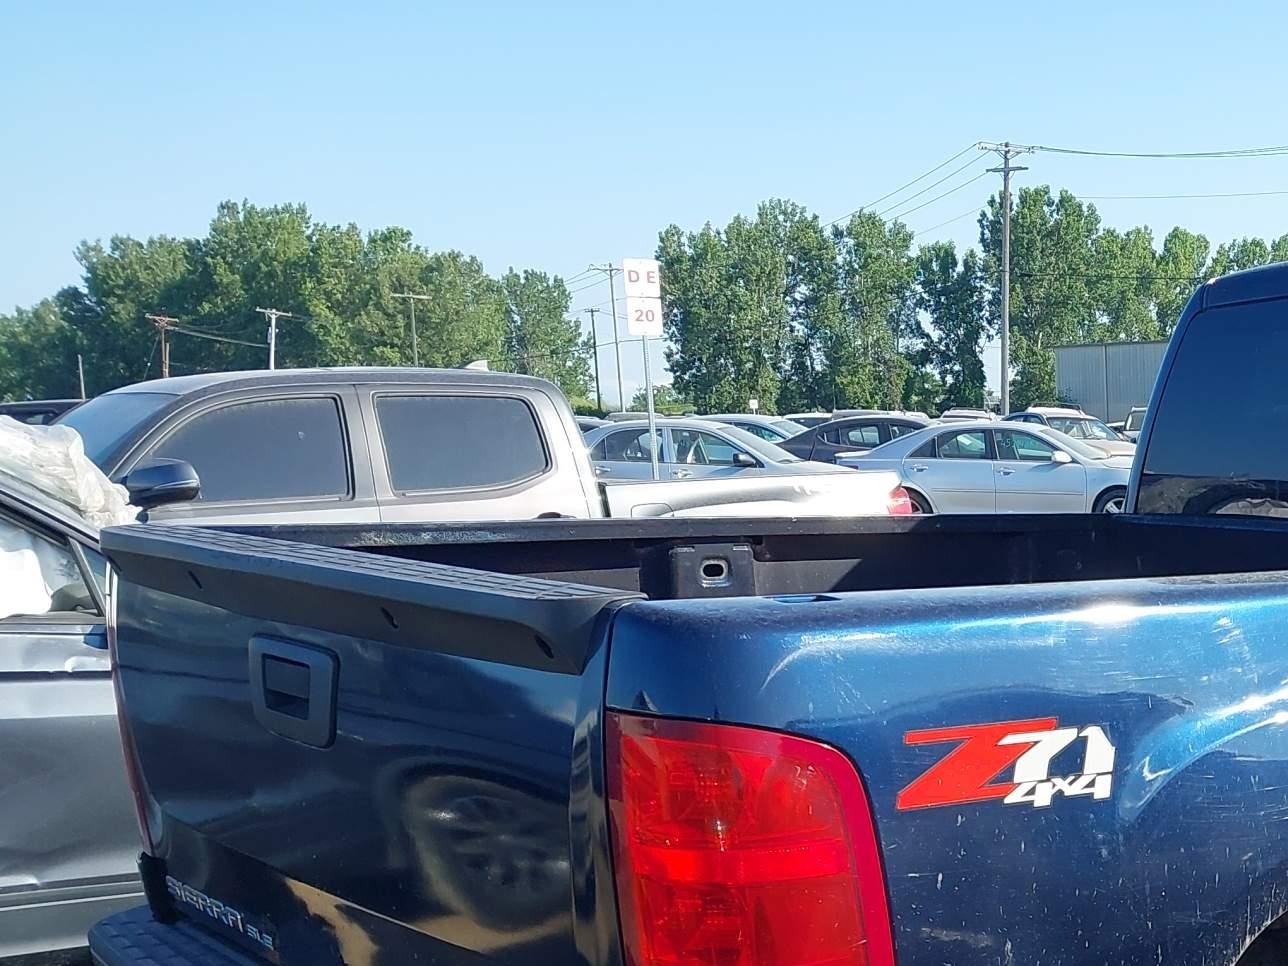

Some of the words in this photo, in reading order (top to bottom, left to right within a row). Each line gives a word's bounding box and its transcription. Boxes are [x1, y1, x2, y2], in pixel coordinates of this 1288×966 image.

[627, 270, 640, 283] D
[646, 271, 657, 284] E
[634, 309, 655, 322] 20
[896, 717, 1116, 811] Z71
[165, 875, 244, 933] SIERRA
